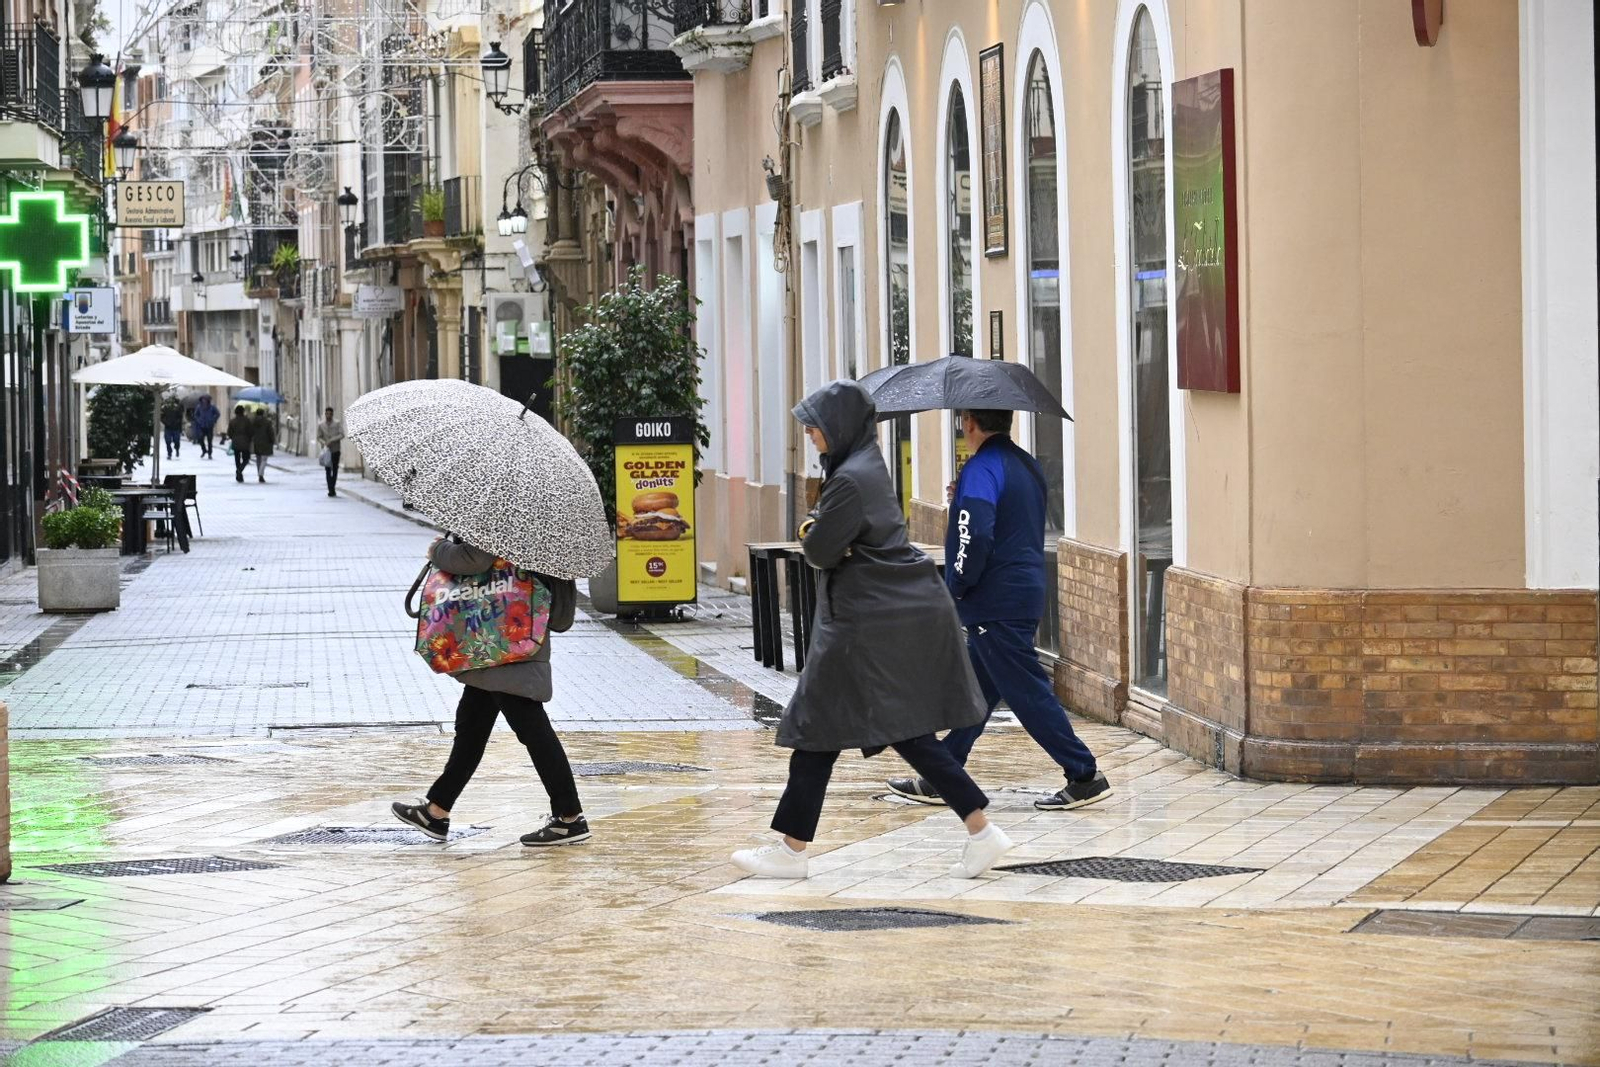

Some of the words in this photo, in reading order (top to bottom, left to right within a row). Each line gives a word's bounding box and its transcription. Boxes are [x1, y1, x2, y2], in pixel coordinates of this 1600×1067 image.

[125, 185, 175, 201] GESCO
[635, 422, 671, 437] GOIKO
[623, 461, 685, 470] GOLDEN
[629, 470, 680, 479] GLAZE
[635, 478, 674, 490] donuts
[435, 575, 513, 606] Desigual
